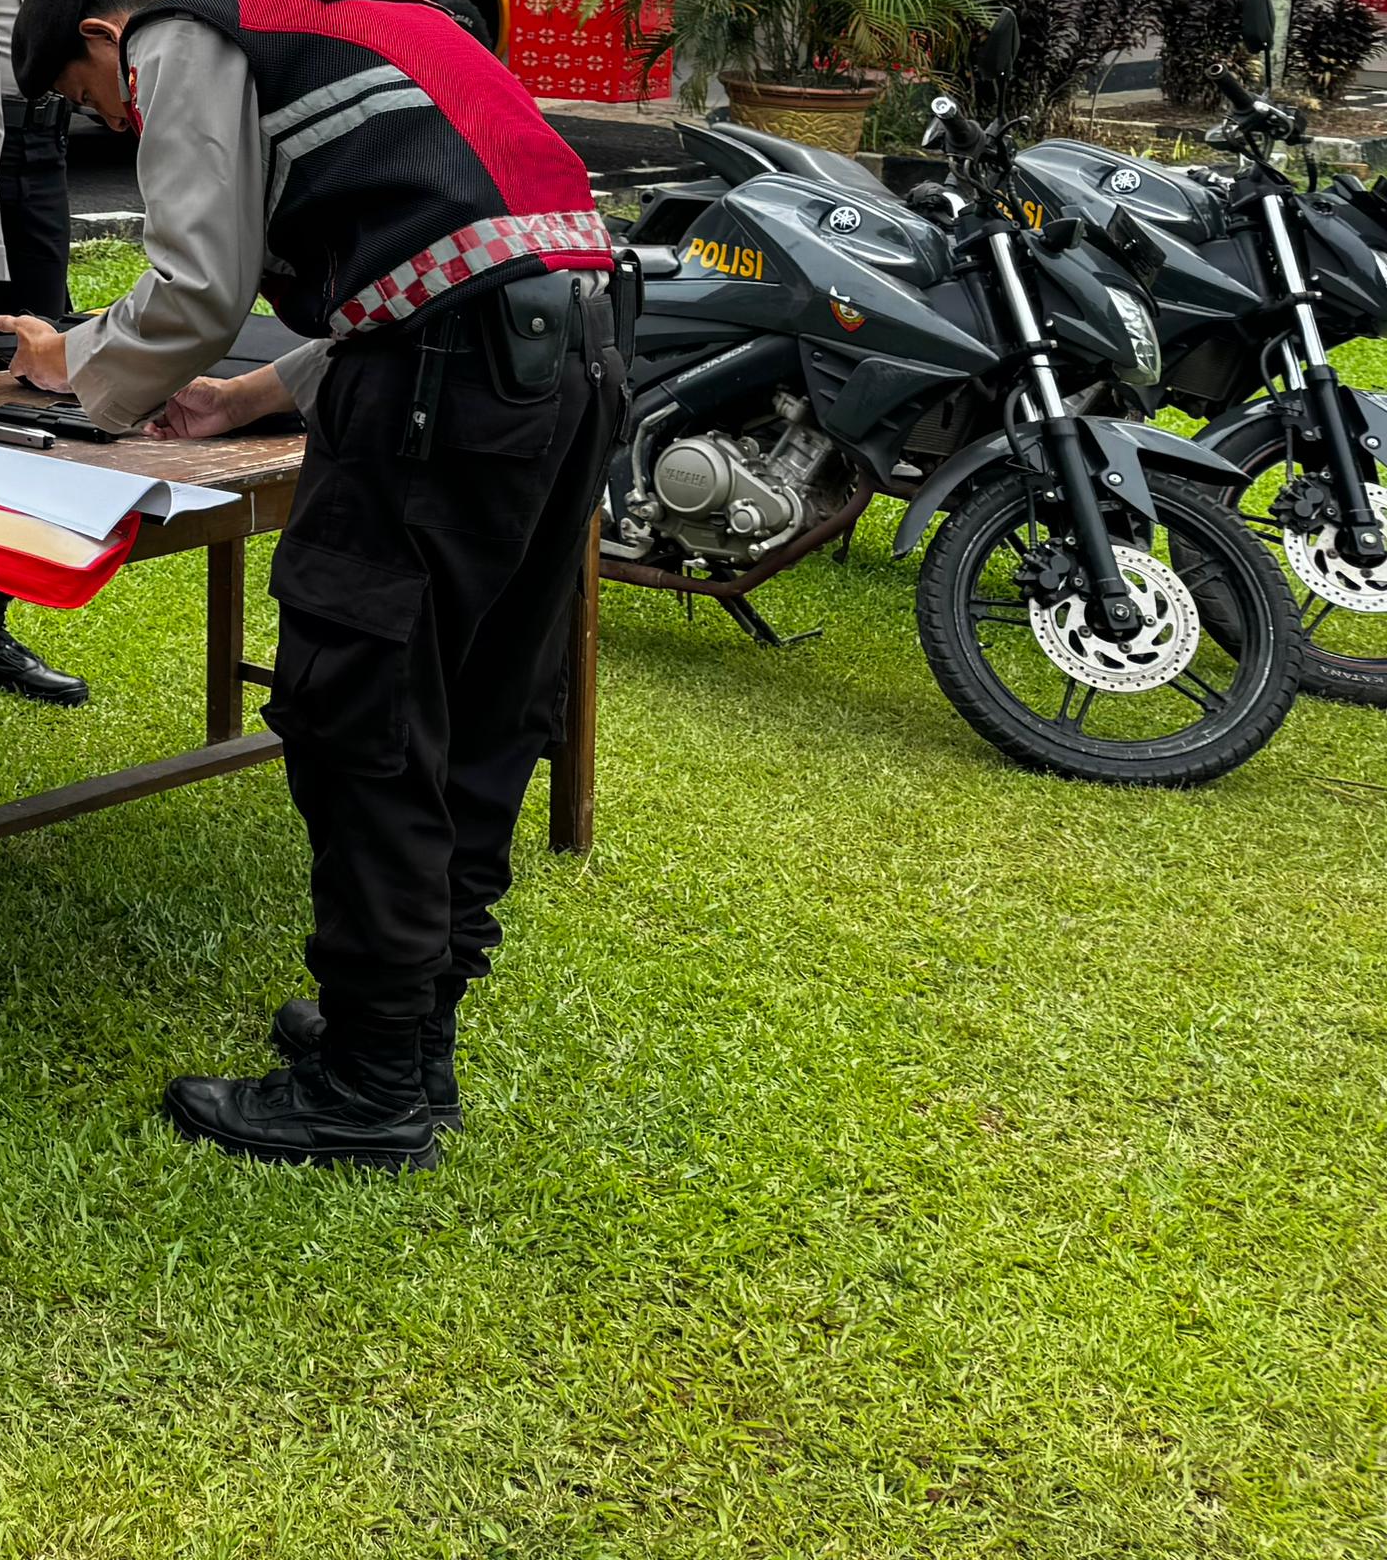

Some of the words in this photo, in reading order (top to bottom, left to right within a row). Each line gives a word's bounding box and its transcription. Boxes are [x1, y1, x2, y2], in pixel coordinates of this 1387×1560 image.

[683, 238, 763, 280] POLISI
[665, 467, 708, 488] YAMAHA
[1319, 665, 1385, 683] KATANA
